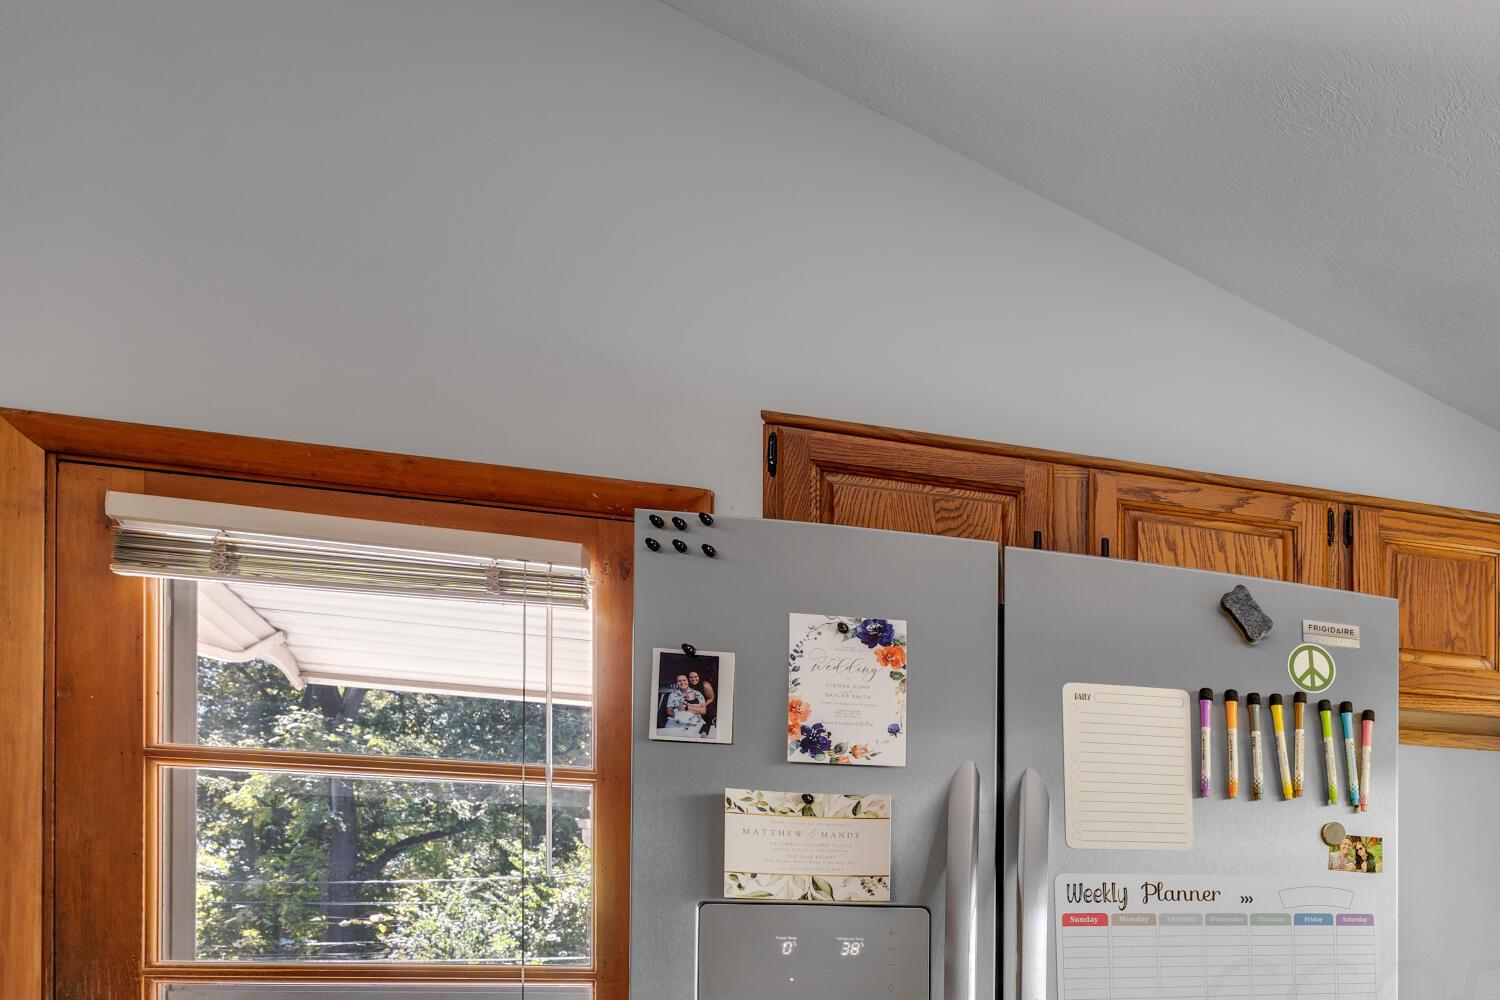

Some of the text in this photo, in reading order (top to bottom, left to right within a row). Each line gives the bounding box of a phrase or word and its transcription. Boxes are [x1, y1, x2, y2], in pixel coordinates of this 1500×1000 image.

[1308, 624, 1355, 636] FRIGIDAIRE
[809, 649, 877, 682] wedding
[1074, 692, 1091, 701] DAILY
[742, 828, 802, 837] MATTHEW
[821, 831, 860, 839] MANDY
[1066, 882, 1221, 911] Weekly Planner
[1069, 916, 1099, 924] Sunday
[1119, 916, 1149, 924] Monday
[1304, 916, 1323, 924] Friday
